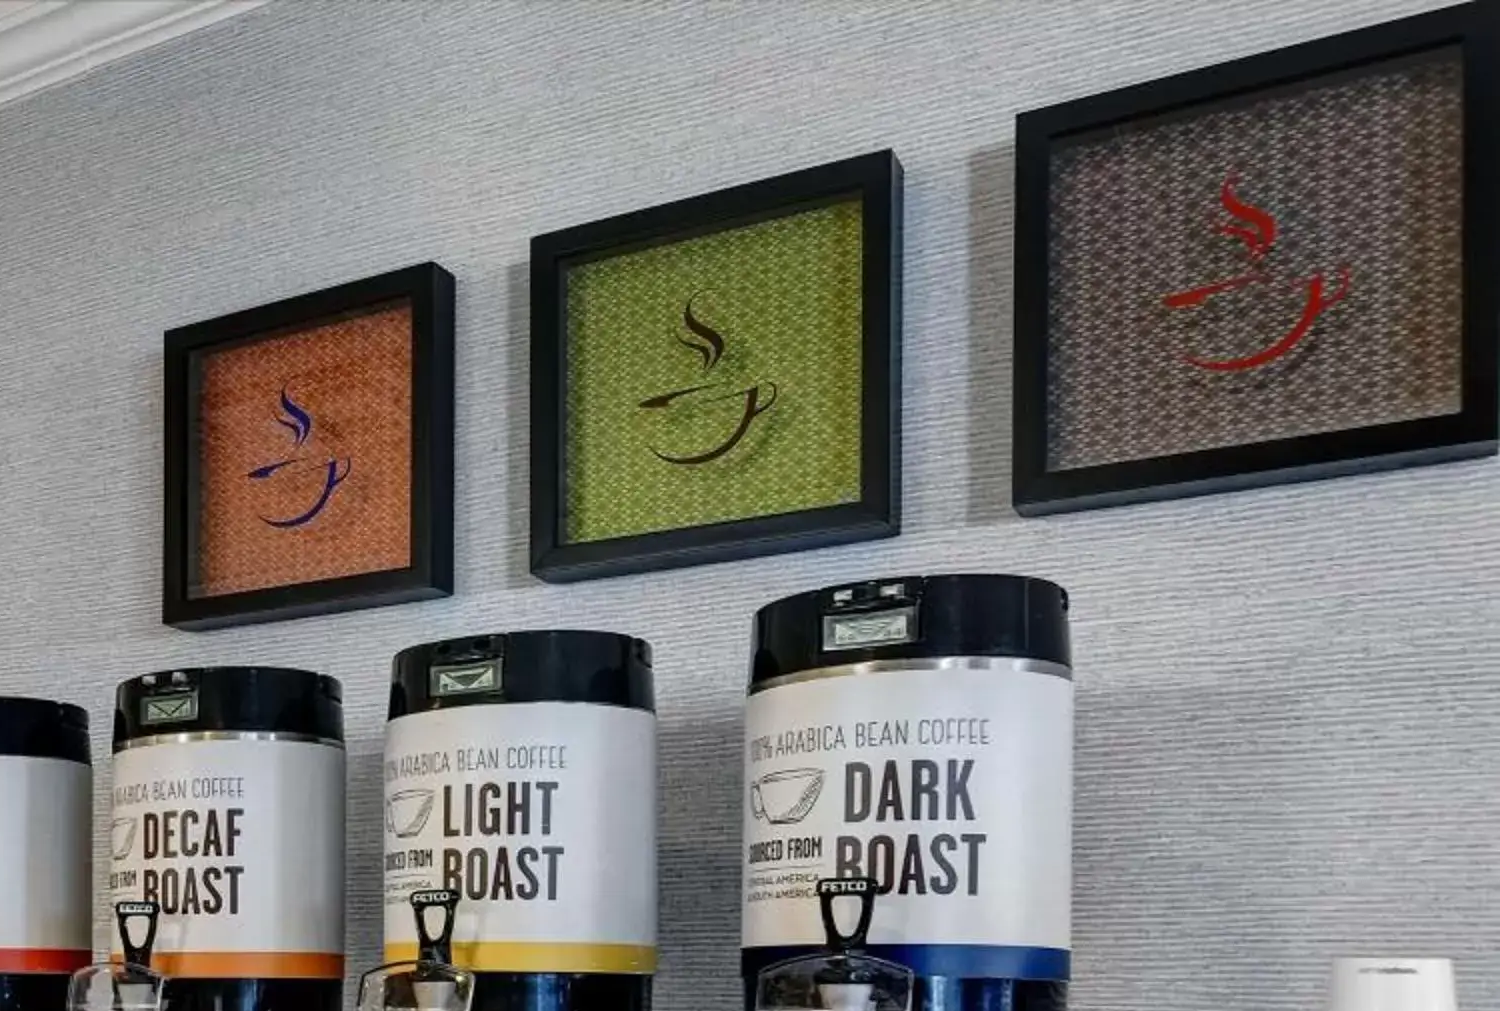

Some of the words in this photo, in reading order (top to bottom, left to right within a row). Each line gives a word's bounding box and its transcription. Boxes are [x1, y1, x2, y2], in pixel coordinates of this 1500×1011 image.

[457, 748, 499, 772] BEAN
[507, 746, 567, 769] COFFEE
[774, 725, 846, 757] ARABICA
[855, 720, 909, 748] BEAN
[918, 718, 991, 746] COFFEE
[153, 779, 187, 801] BEAN
[192, 777, 244, 799] COFFEE
[444, 781, 559, 837] LIGHT
[844, 759, 976, 823] DARK
[144, 808, 244, 860] DECAF
[788, 836, 822, 860] FROM
[444, 846, 564, 900] ROAST
[822, 881, 867, 893] FETCO
[836, 834, 987, 896] ROAST
[143, 866, 245, 914] ROAST
